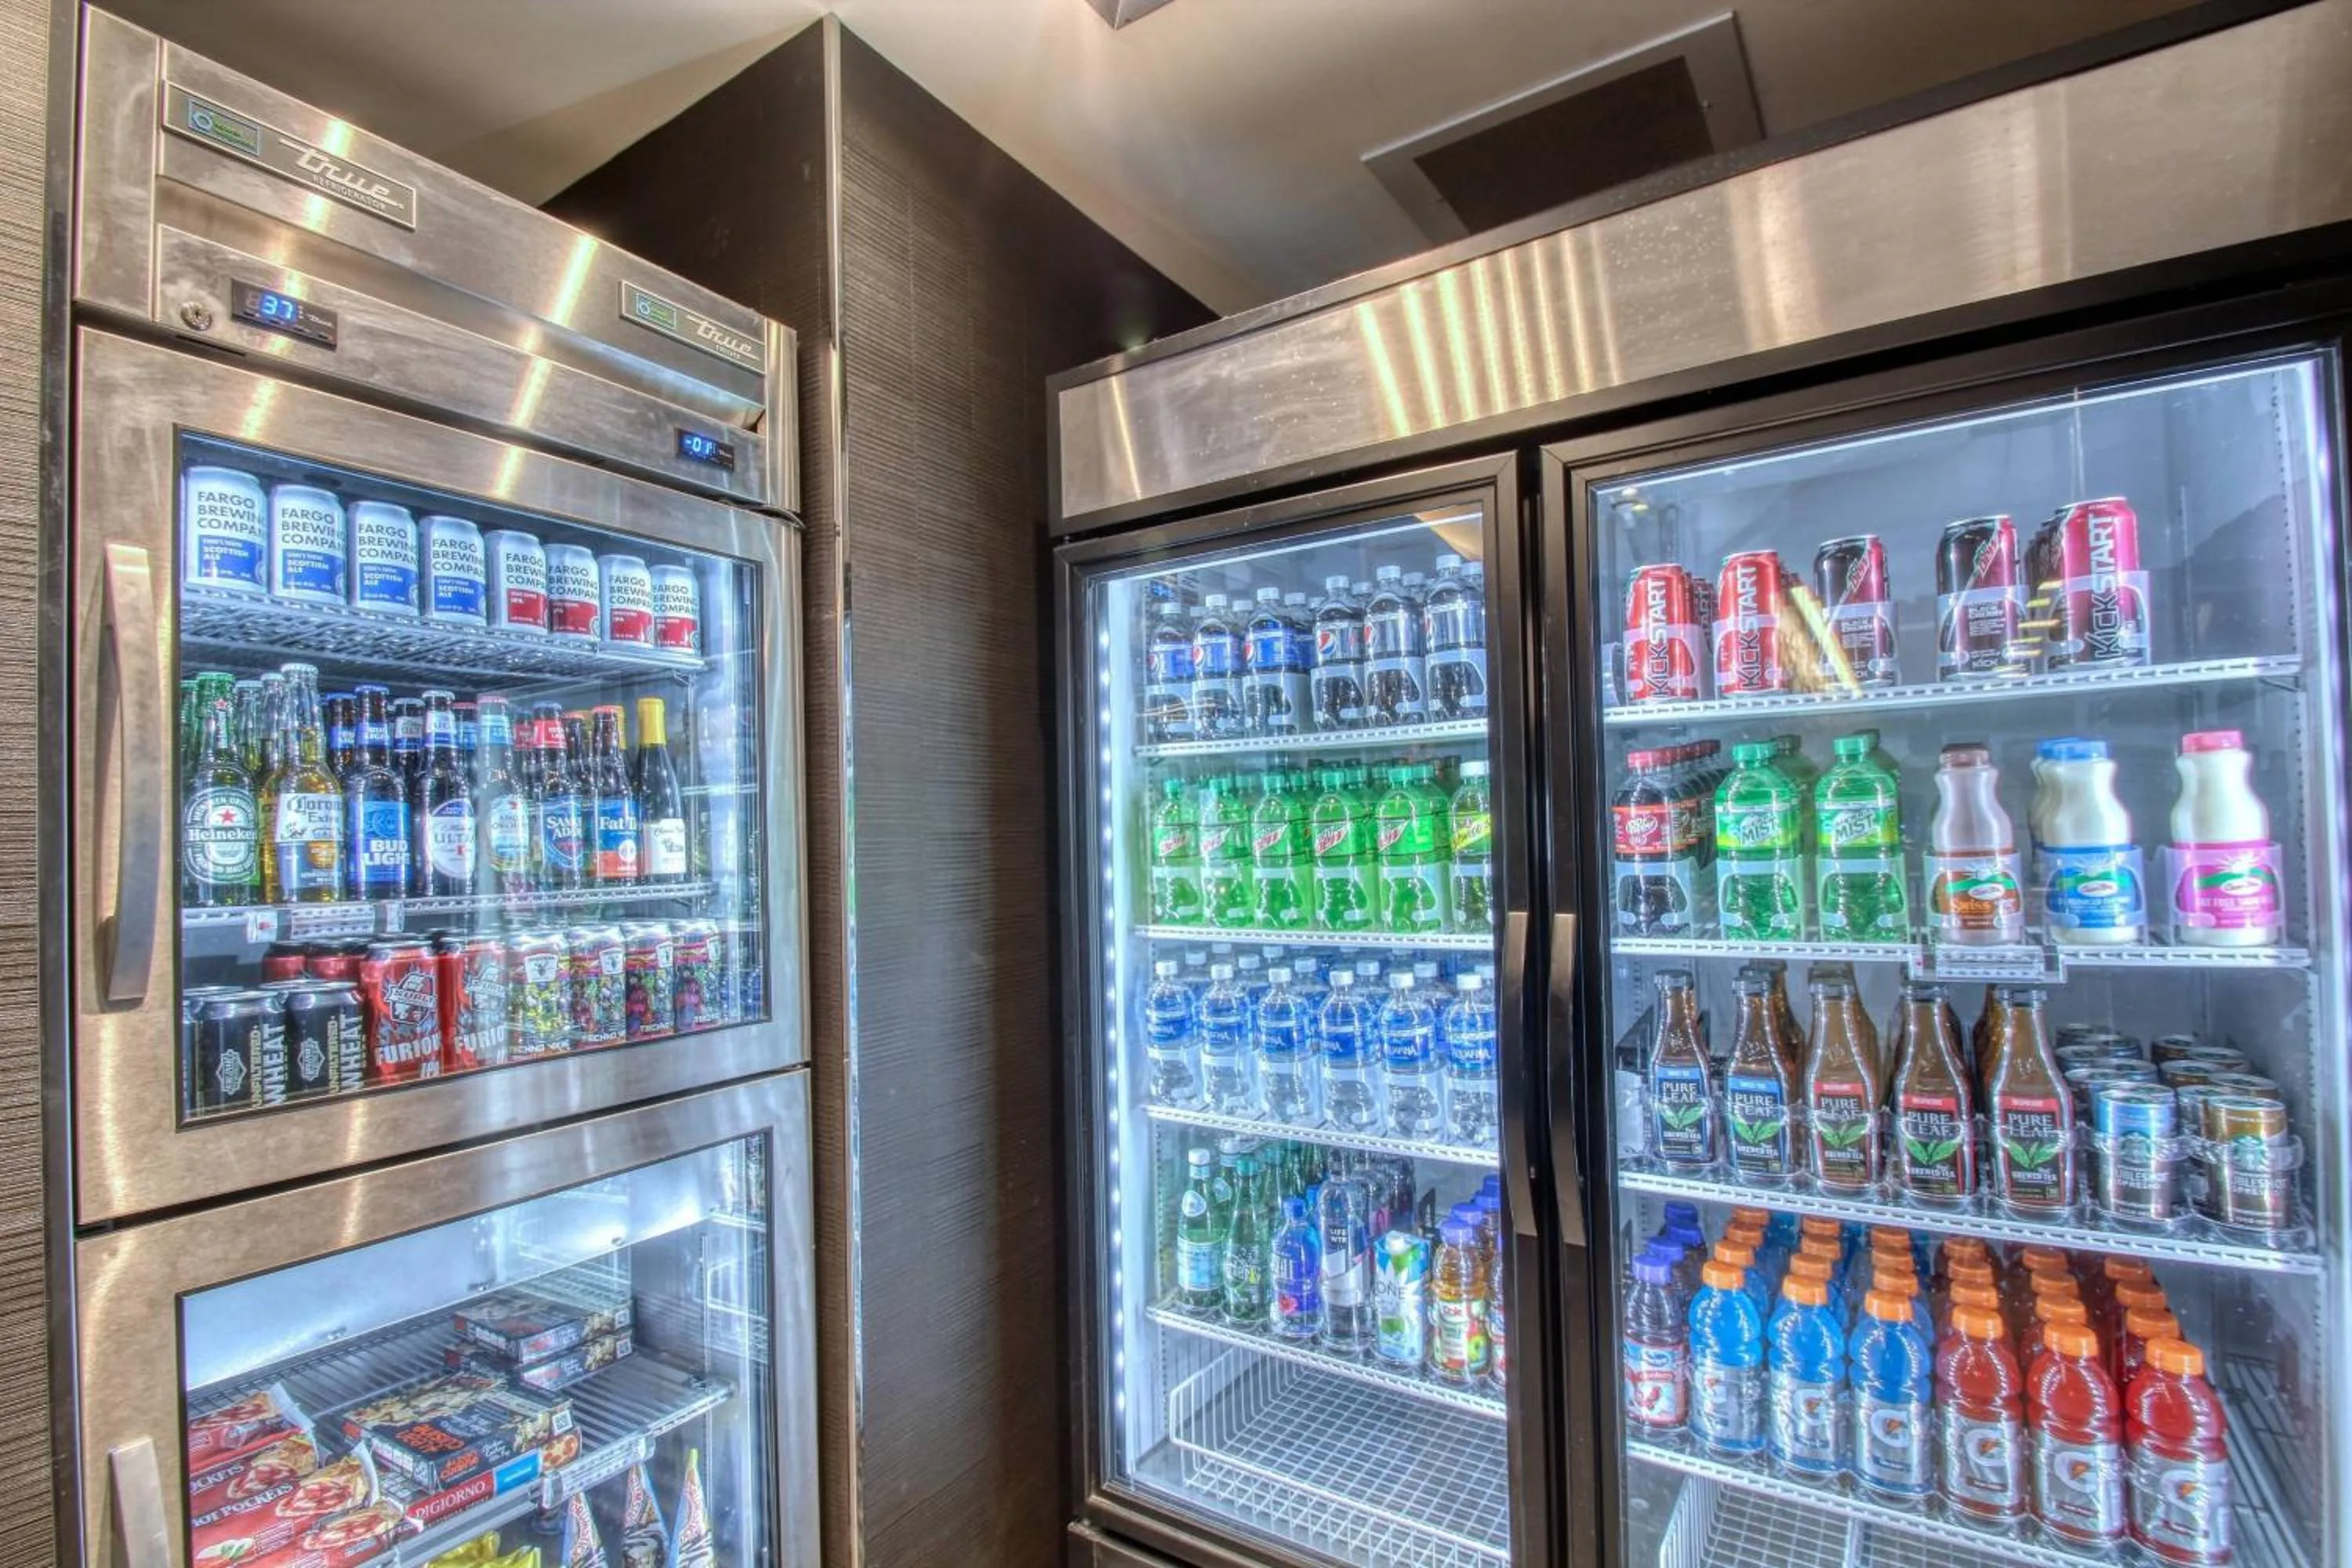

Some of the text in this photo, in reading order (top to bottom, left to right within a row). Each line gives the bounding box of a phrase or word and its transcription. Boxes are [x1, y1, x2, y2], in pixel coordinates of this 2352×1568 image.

[262, 295, 293, 319] 37
[198, 492, 255, 509] FARGO
[282, 508, 334, 524] FARGO
[198, 517, 263, 536] COMPA
[359, 524, 407, 539] FARGO
[282, 534, 345, 550] COMPAN
[433, 539, 477, 553] FARGO
[358, 548, 418, 564] COMPAN
[506, 554, 543, 568] FARGO
[432, 561, 484, 577] COMPAN
[549, 565, 587, 576] FARGO
[506, 575, 546, 588] COMPA
[609, 575, 645, 587] FARGO
[2085, 514, 2122, 659] KICKSTART
[549, 586, 597, 600] COMPAN
[654, 584, 688, 594] FARGO
[609, 595, 652, 608] COMPA
[654, 603, 697, 615] COMPAN
[1737, 564, 1761, 690] KICKSTART
[1646, 576, 1670, 699] KICKSTART
[1836, 814, 1874, 840] MIST
[370, 840, 408, 852] BUD
[340, 1014, 363, 1090] WHEAT
[264, 1023, 287, 1105] WHEAT
[1664, 1081, 1697, 1092] PURE
[1736, 1093, 1773, 1105] PURE
[1821, 1098, 1859, 1109] PURE
[1907, 1111, 1951, 1124] PURE
[2009, 1113, 2052, 1126] PURE
[1376, 1281, 1405, 1300] ONE
[416, 1480, 485, 1518] DIGIORNO
